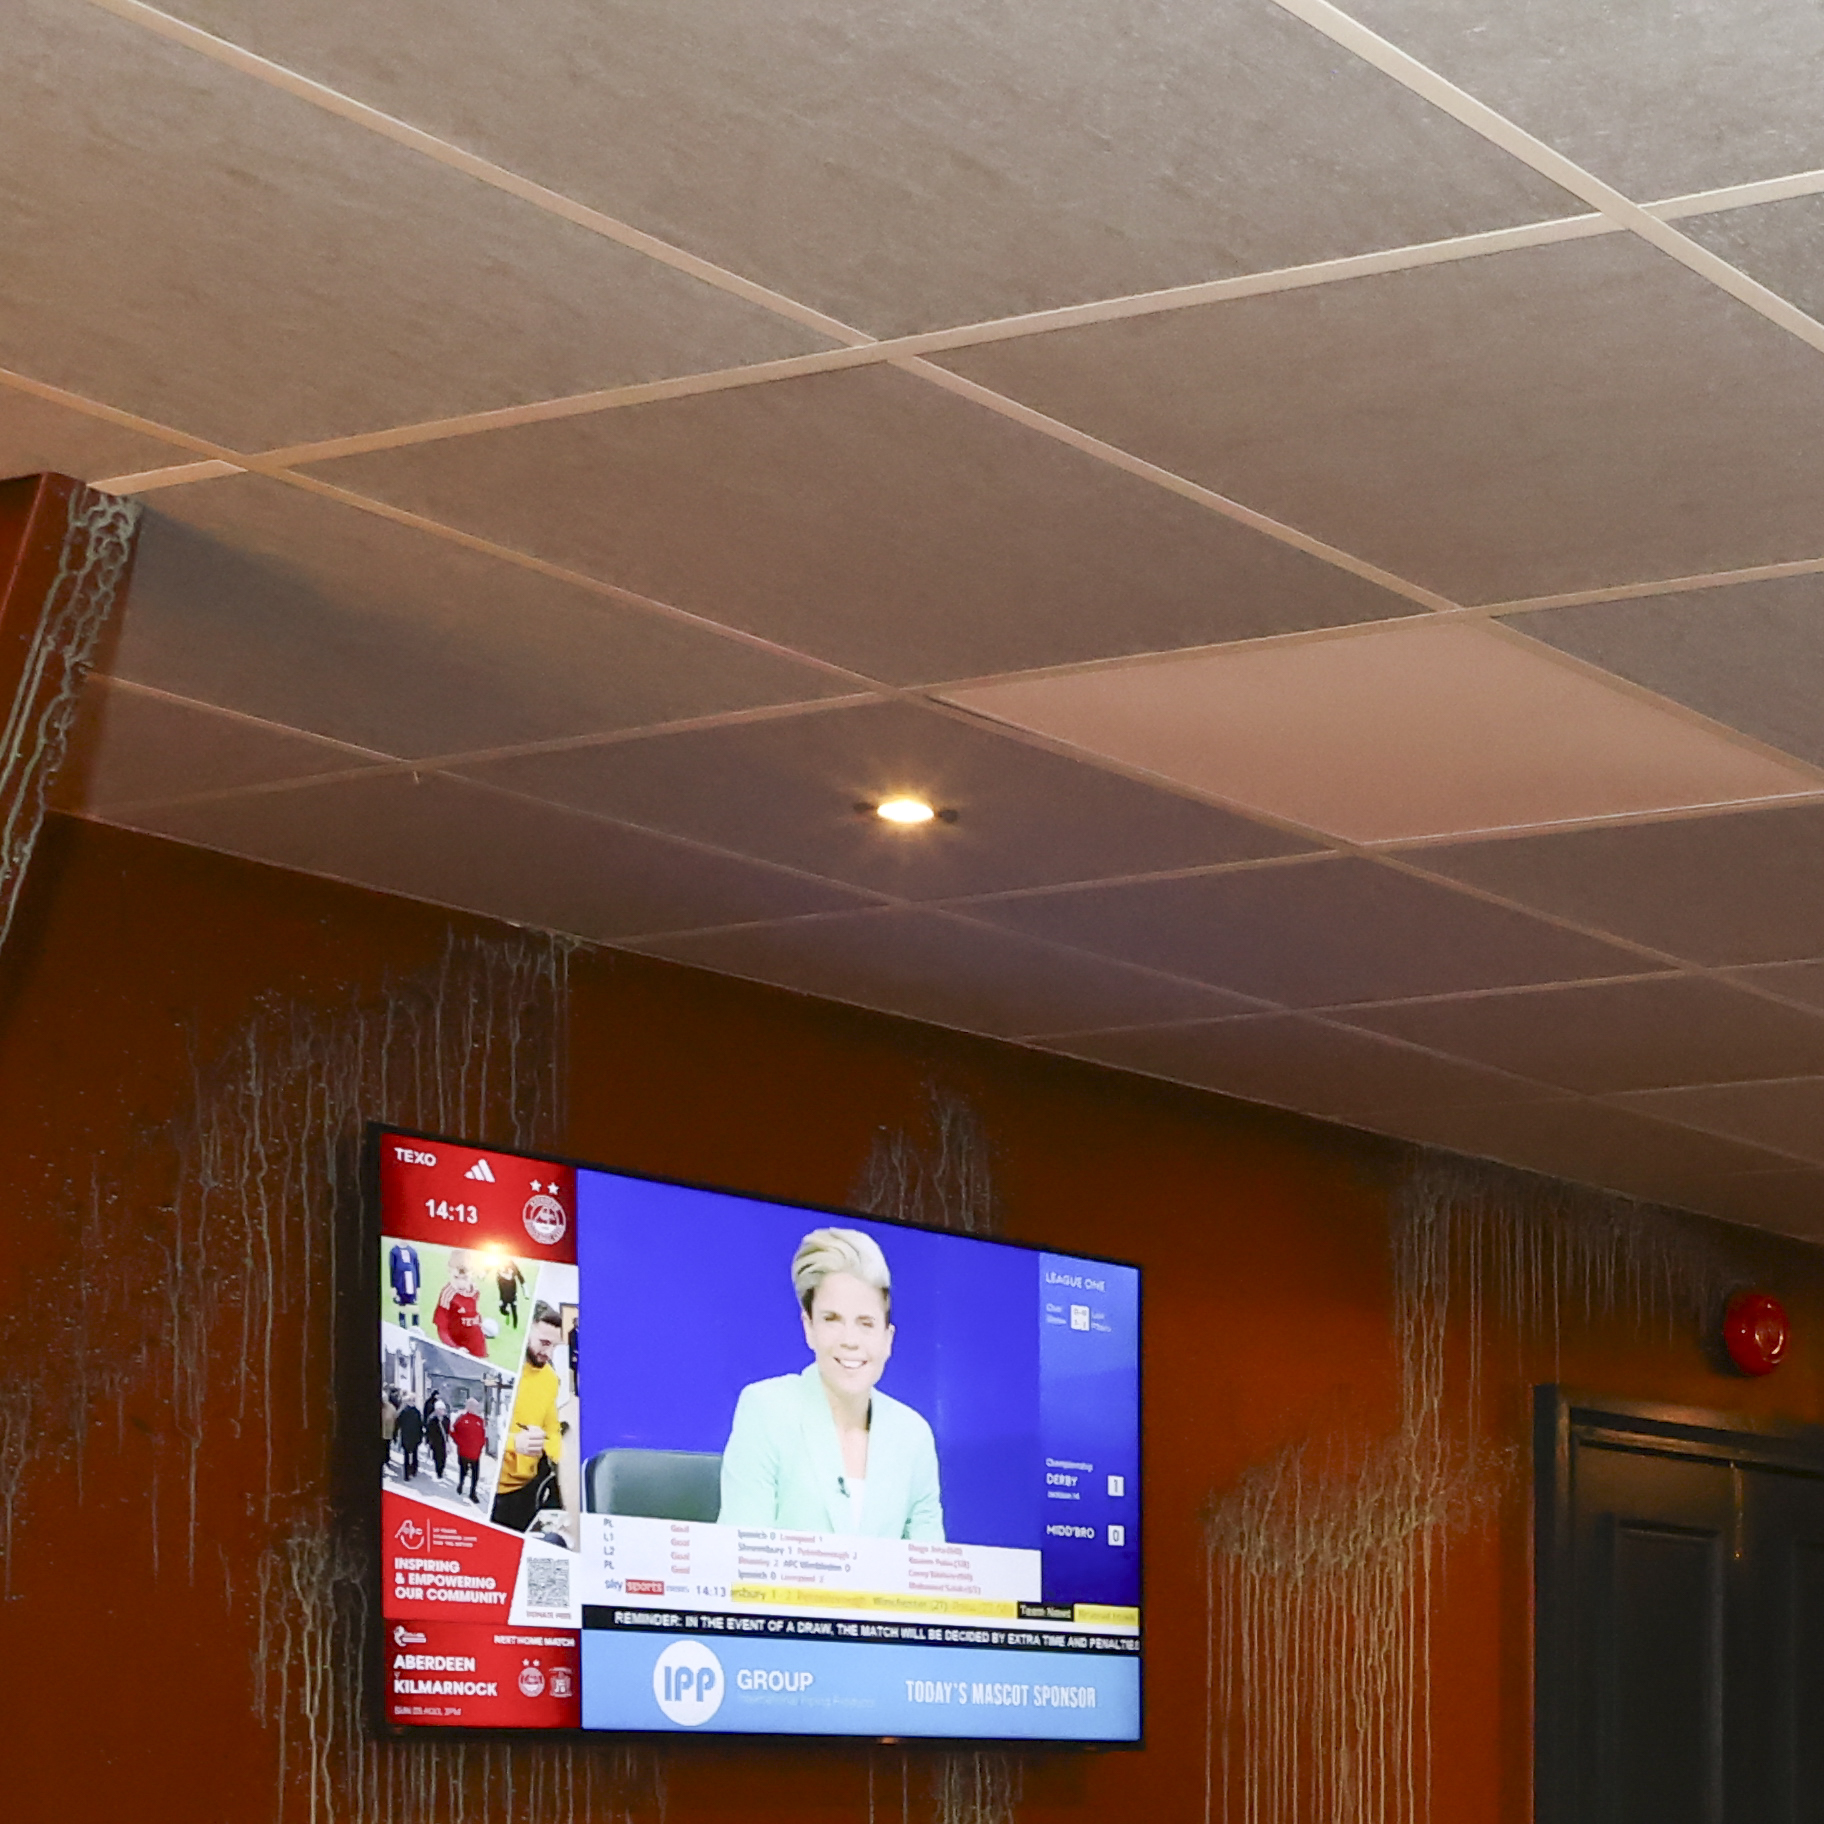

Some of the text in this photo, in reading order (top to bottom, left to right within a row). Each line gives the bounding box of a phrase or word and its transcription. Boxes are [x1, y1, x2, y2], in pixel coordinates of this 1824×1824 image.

[394, 1147, 437, 1167] TEXO
[425, 1199, 478, 1224] 14:13
[1045, 1272, 1106, 1292] LEAGUE ONE
[1046, 1473, 1079, 1487] DERBY
[394, 1558, 460, 1574] INSPIRING
[395, 1573, 496, 1590] & EMPOWERING
[626, 1581, 663, 1594] sports
[395, 1587, 507, 1605] OUR COMMUNITY
[696, 1585, 726, 1597] 14:13
[1019, 1604, 1046, 1617] Team
[1046, 1607, 1072, 1619] News
[614, 1611, 683, 1627] REMINDER:
[685, 1616, 699, 1628] IN
[700, 1616, 725, 1630] THE
[726, 1618, 766, 1631] EVENT
[767, 1620, 784, 1632] OF
[785, 1621, 796, 1633] A
[797, 1621, 834, 1637] DRAW,
[836, 1623, 858, 1636] THE
[860, 1625, 899, 1638] MATCH
[900, 1628, 926, 1640] WILL
[927, 1629, 943, 1640] BE
[945, 1629, 990, 1643] DECIDED
[991, 1632, 1006, 1644] BY
[1007, 1634, 1041, 1646] EXTRA
[1042, 1635, 1066, 1647] TIME
[1067, 1637, 1087, 1648] AND
[393, 1655, 476, 1672] ABERDEEN
[393, 1680, 498, 1696] KILMARNOCK
[663, 1665, 716, 1702] IPP
[736, 1669, 814, 1692] GROUP
[904, 1680, 968, 1706] TODAY'S
[971, 1682, 1030, 1708] MASCOT
[1032, 1684, 1097, 1709] SPONSOR
